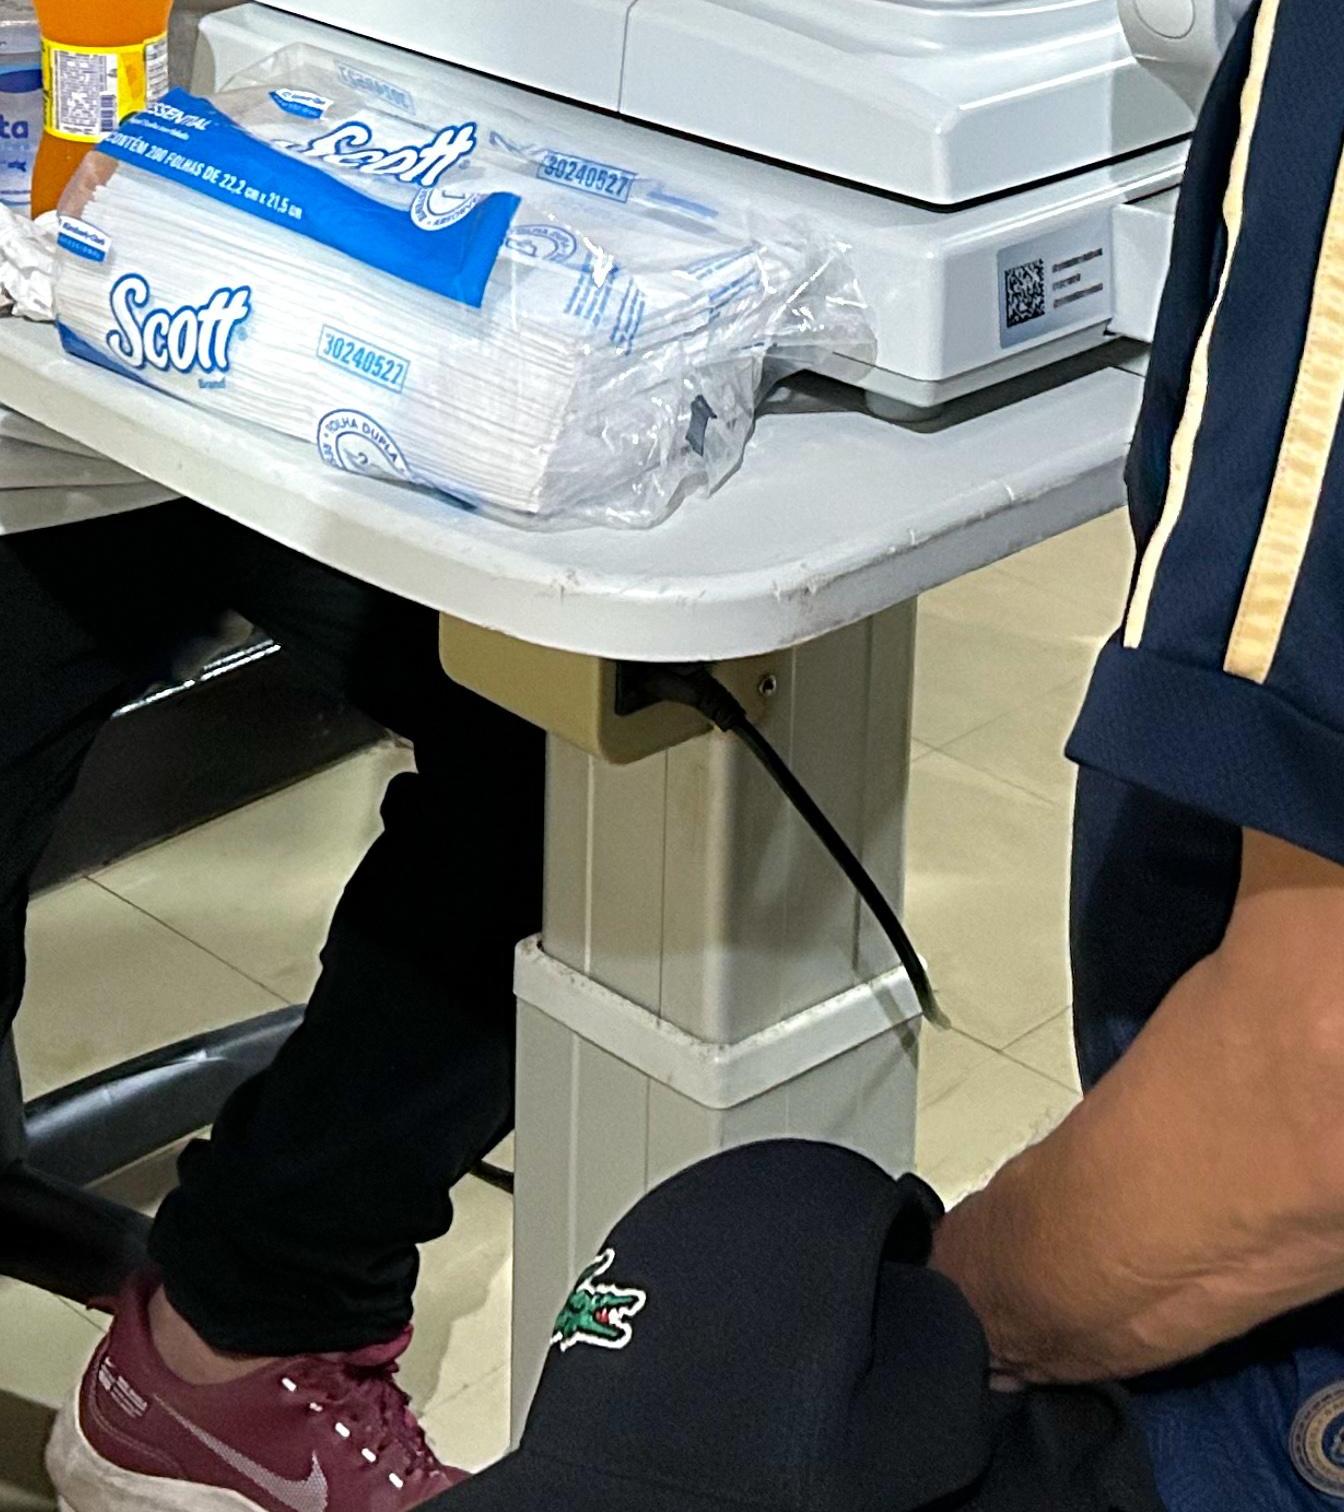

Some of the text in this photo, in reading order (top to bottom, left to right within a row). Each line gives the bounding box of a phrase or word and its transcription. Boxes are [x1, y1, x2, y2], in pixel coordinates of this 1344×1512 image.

[298, 121, 478, 187] Scott
[544, 153, 630, 198] 30240527
[163, 152, 206, 177] FOLHAS
[202, 165, 222, 184] DE
[218, 173, 246, 195] 22,2
[266, 191, 290, 214] 21,5
[106, 272, 251, 374] Scott
[323, 332, 405, 385] 30240527
[362, 421, 398, 463] DUPLA
